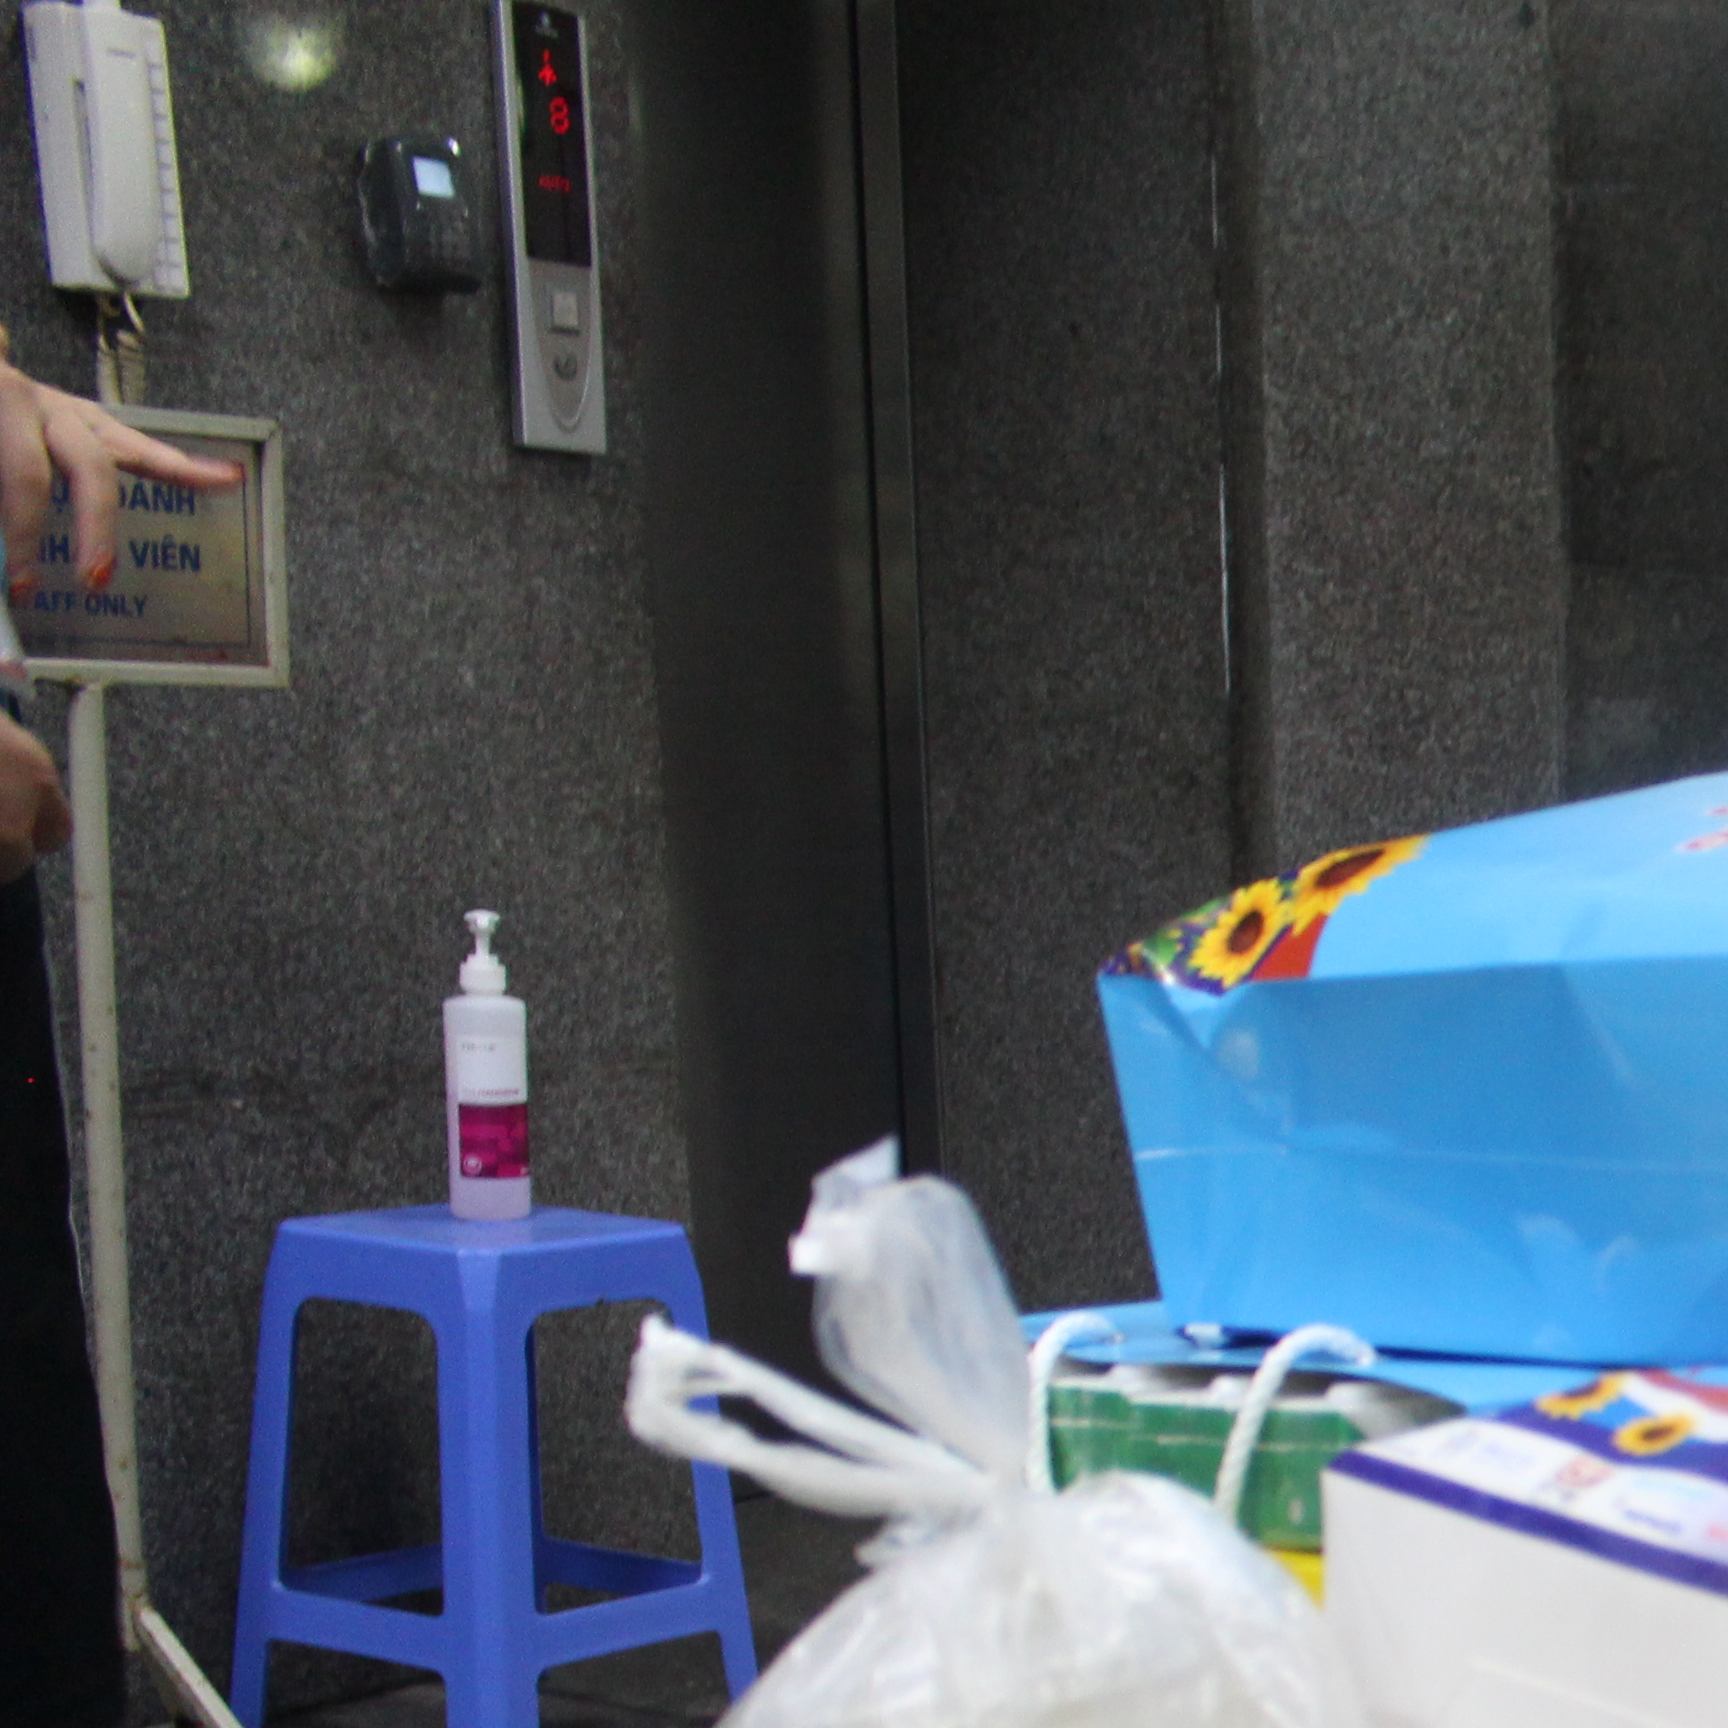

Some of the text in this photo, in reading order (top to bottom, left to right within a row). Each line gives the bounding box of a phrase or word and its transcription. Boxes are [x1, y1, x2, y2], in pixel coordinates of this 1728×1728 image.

[549, 96, 571, 135] 8
[129, 533, 201, 573] VIÊN
[33, 590, 148, 617] AFF ONLY
